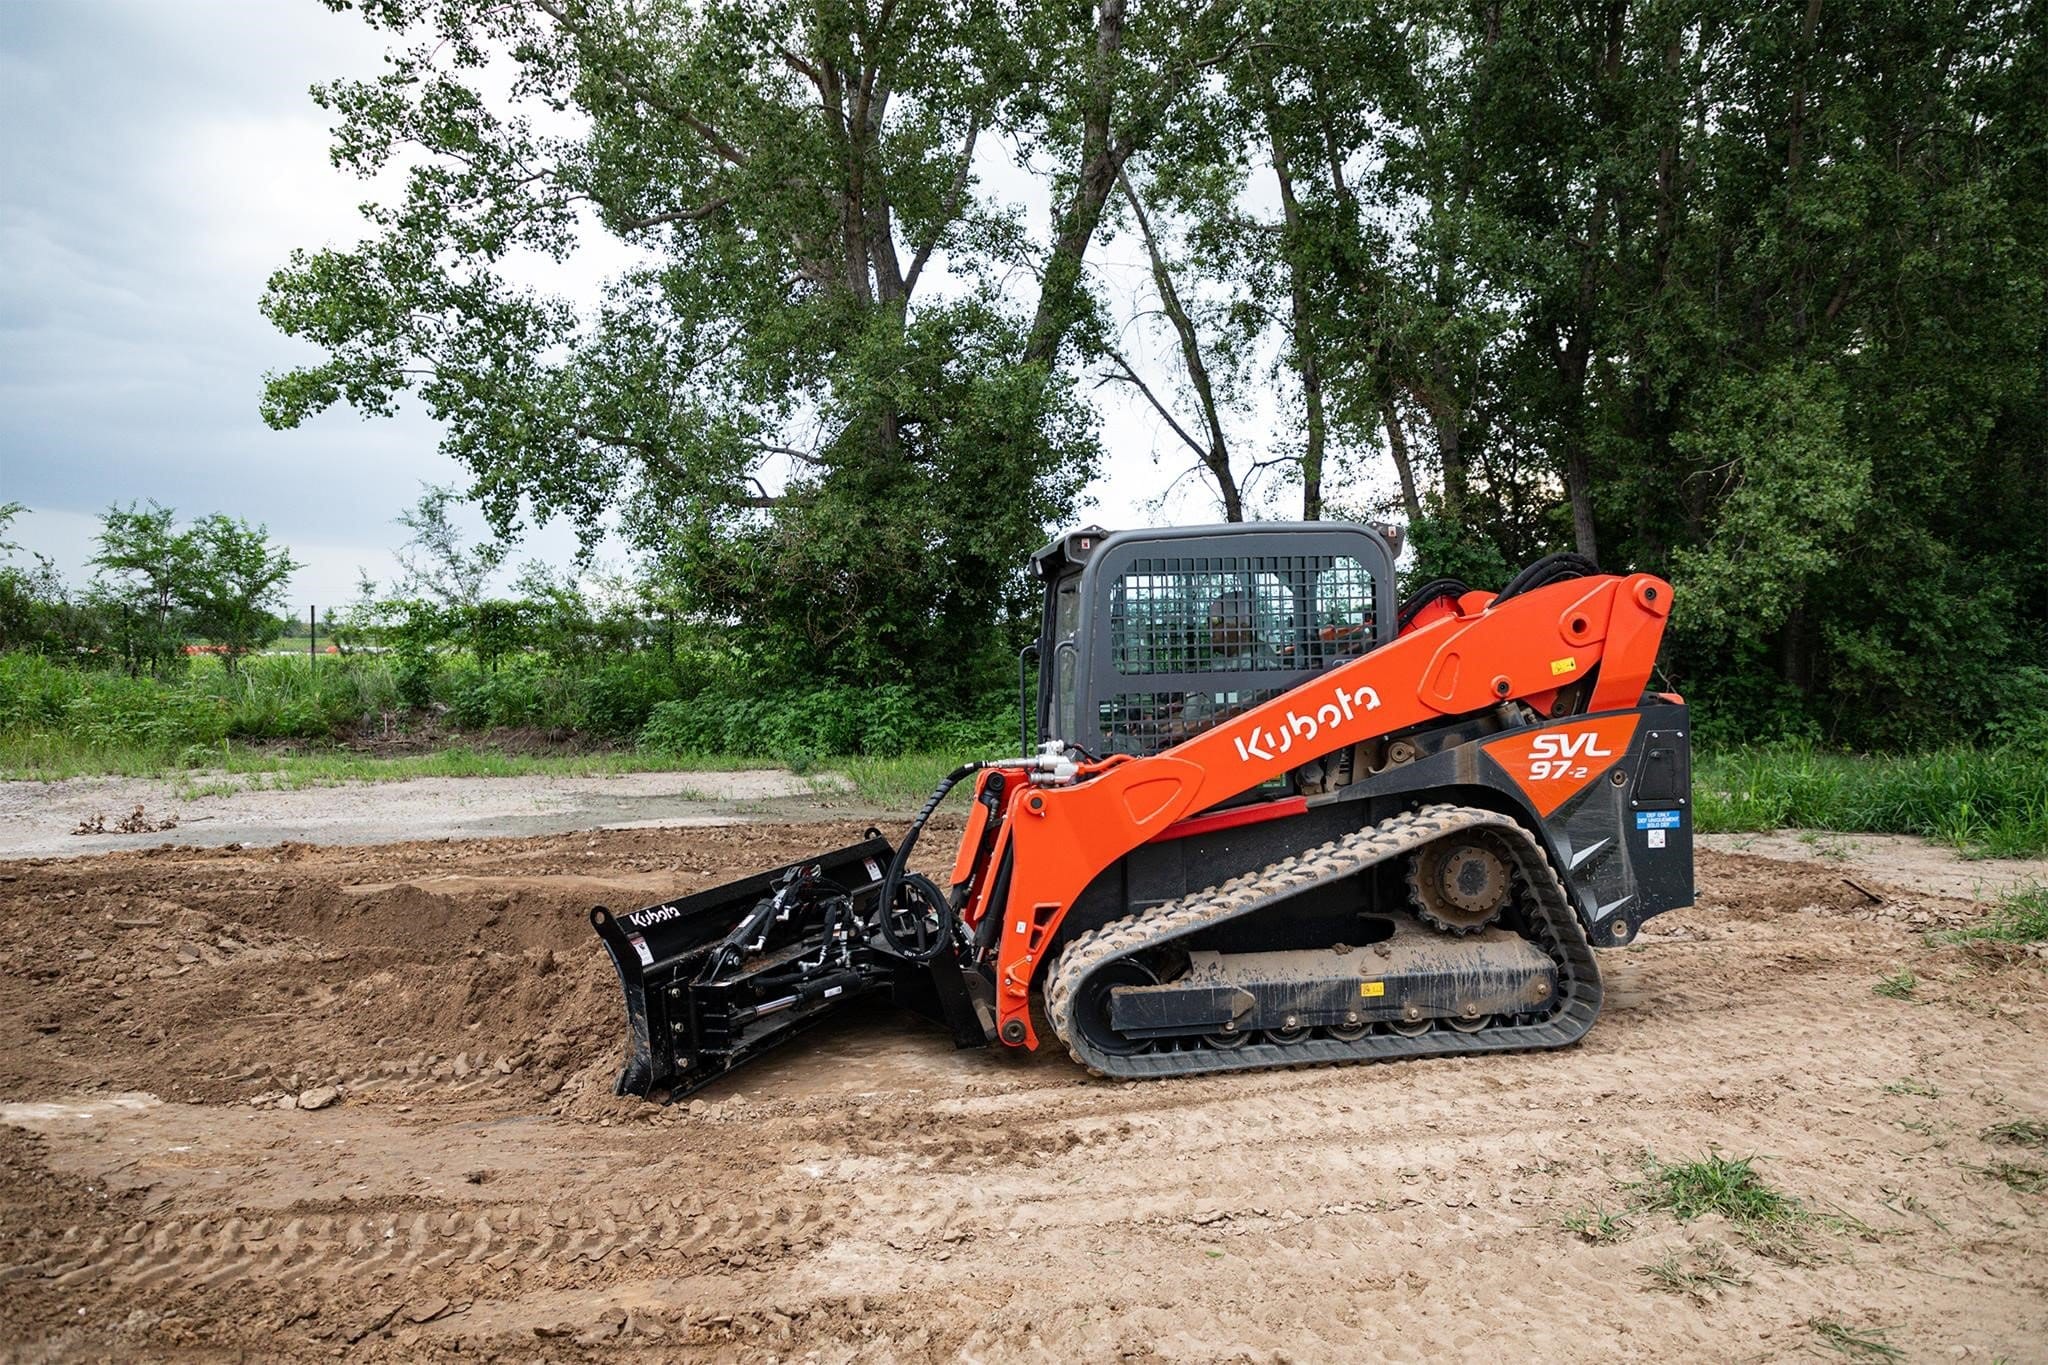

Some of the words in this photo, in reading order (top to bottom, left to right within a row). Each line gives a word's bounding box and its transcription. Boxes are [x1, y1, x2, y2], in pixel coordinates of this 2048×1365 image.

[1233, 685, 1382, 762] Kubota
[1528, 732, 1612, 759] SVL
[1528, 760, 1588, 780] 97-2
[629, 905, 681, 927] Kubota
